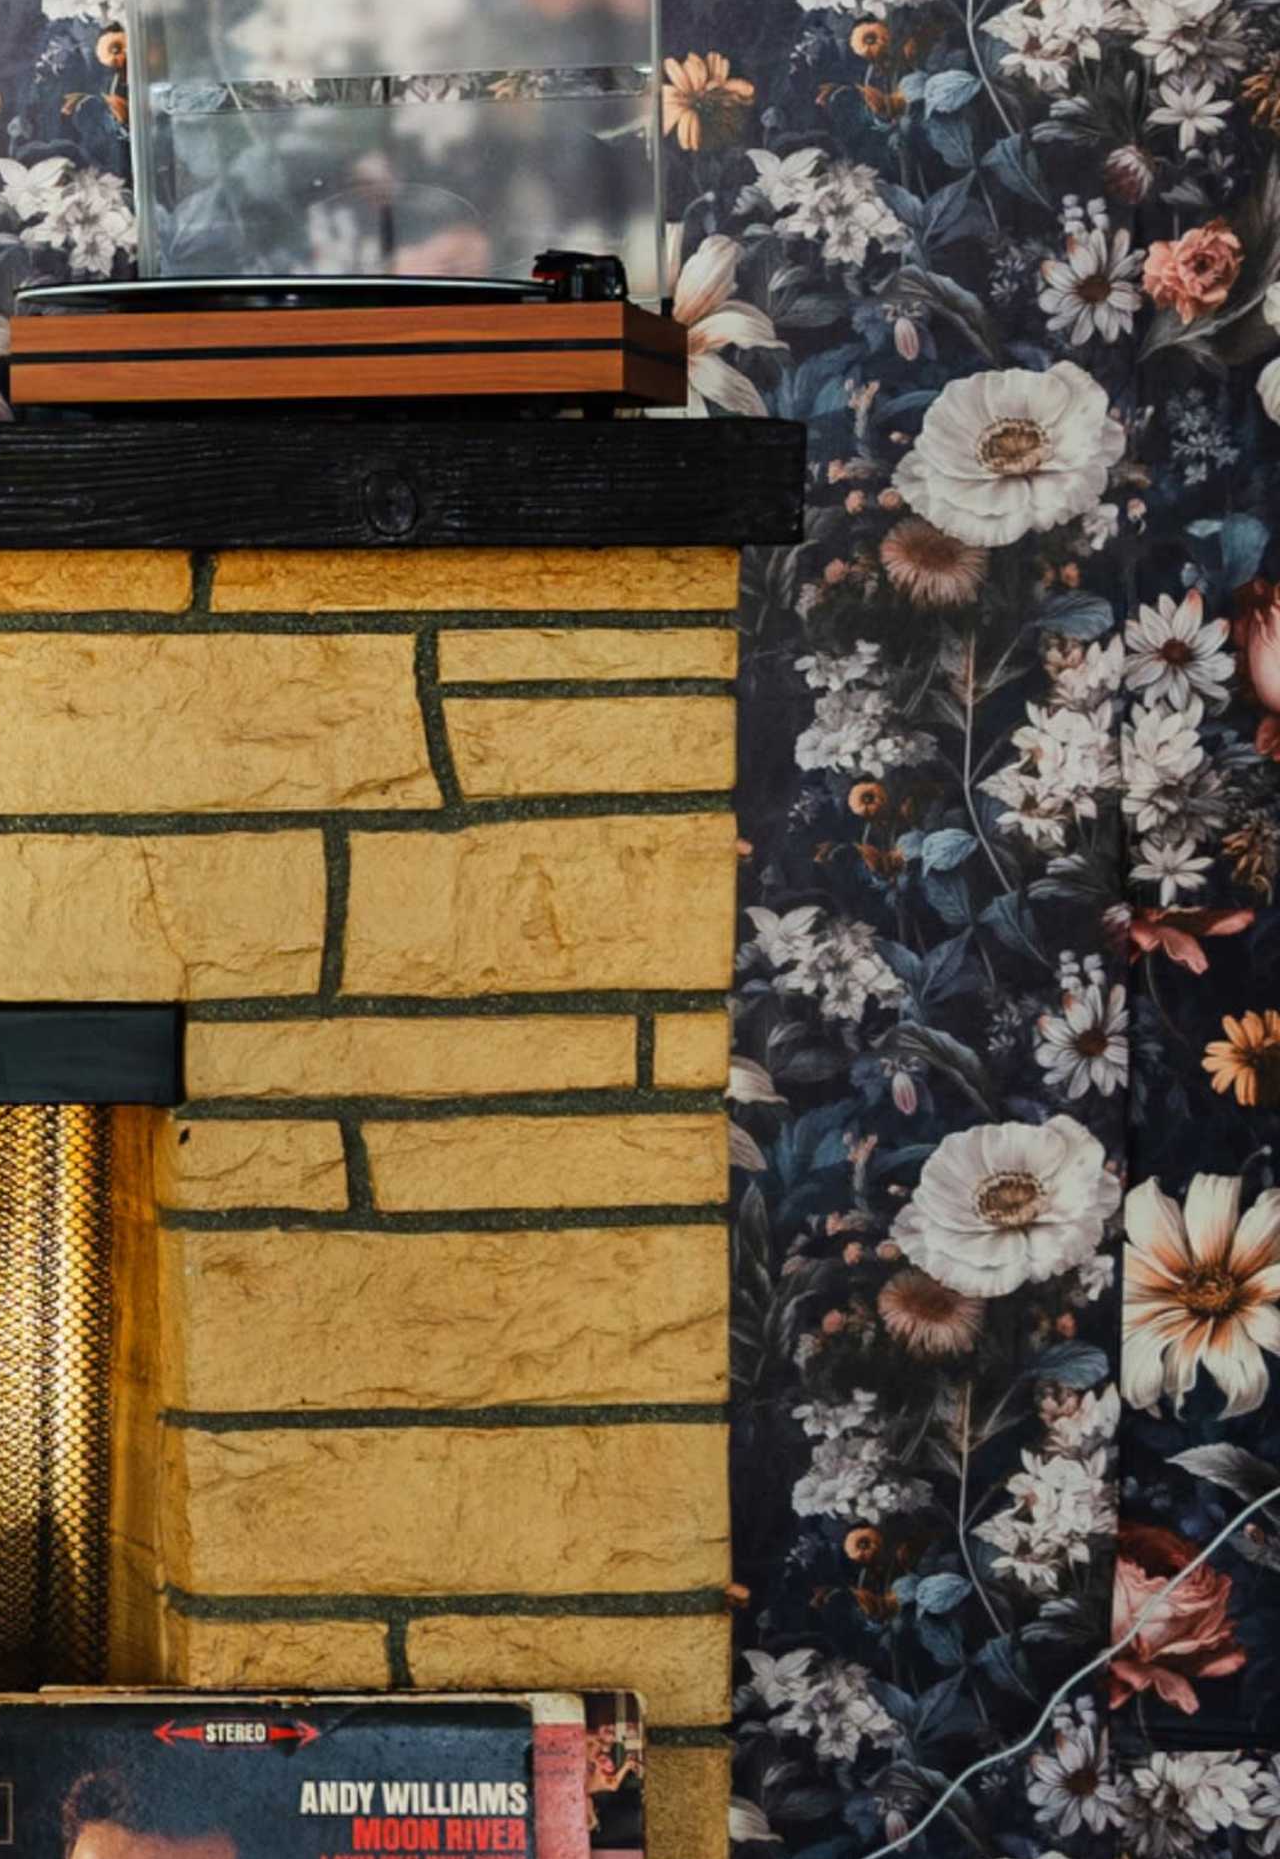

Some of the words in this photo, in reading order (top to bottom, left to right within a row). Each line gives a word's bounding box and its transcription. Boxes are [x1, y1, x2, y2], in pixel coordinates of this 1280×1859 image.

[205, 1723, 267, 1743] STEREO
[300, 1781, 375, 1815] ANDY
[381, 1781, 528, 1816] WILLIAMS
[352, 1816, 439, 1851] MOON
[445, 1816, 528, 1851] RIVER
